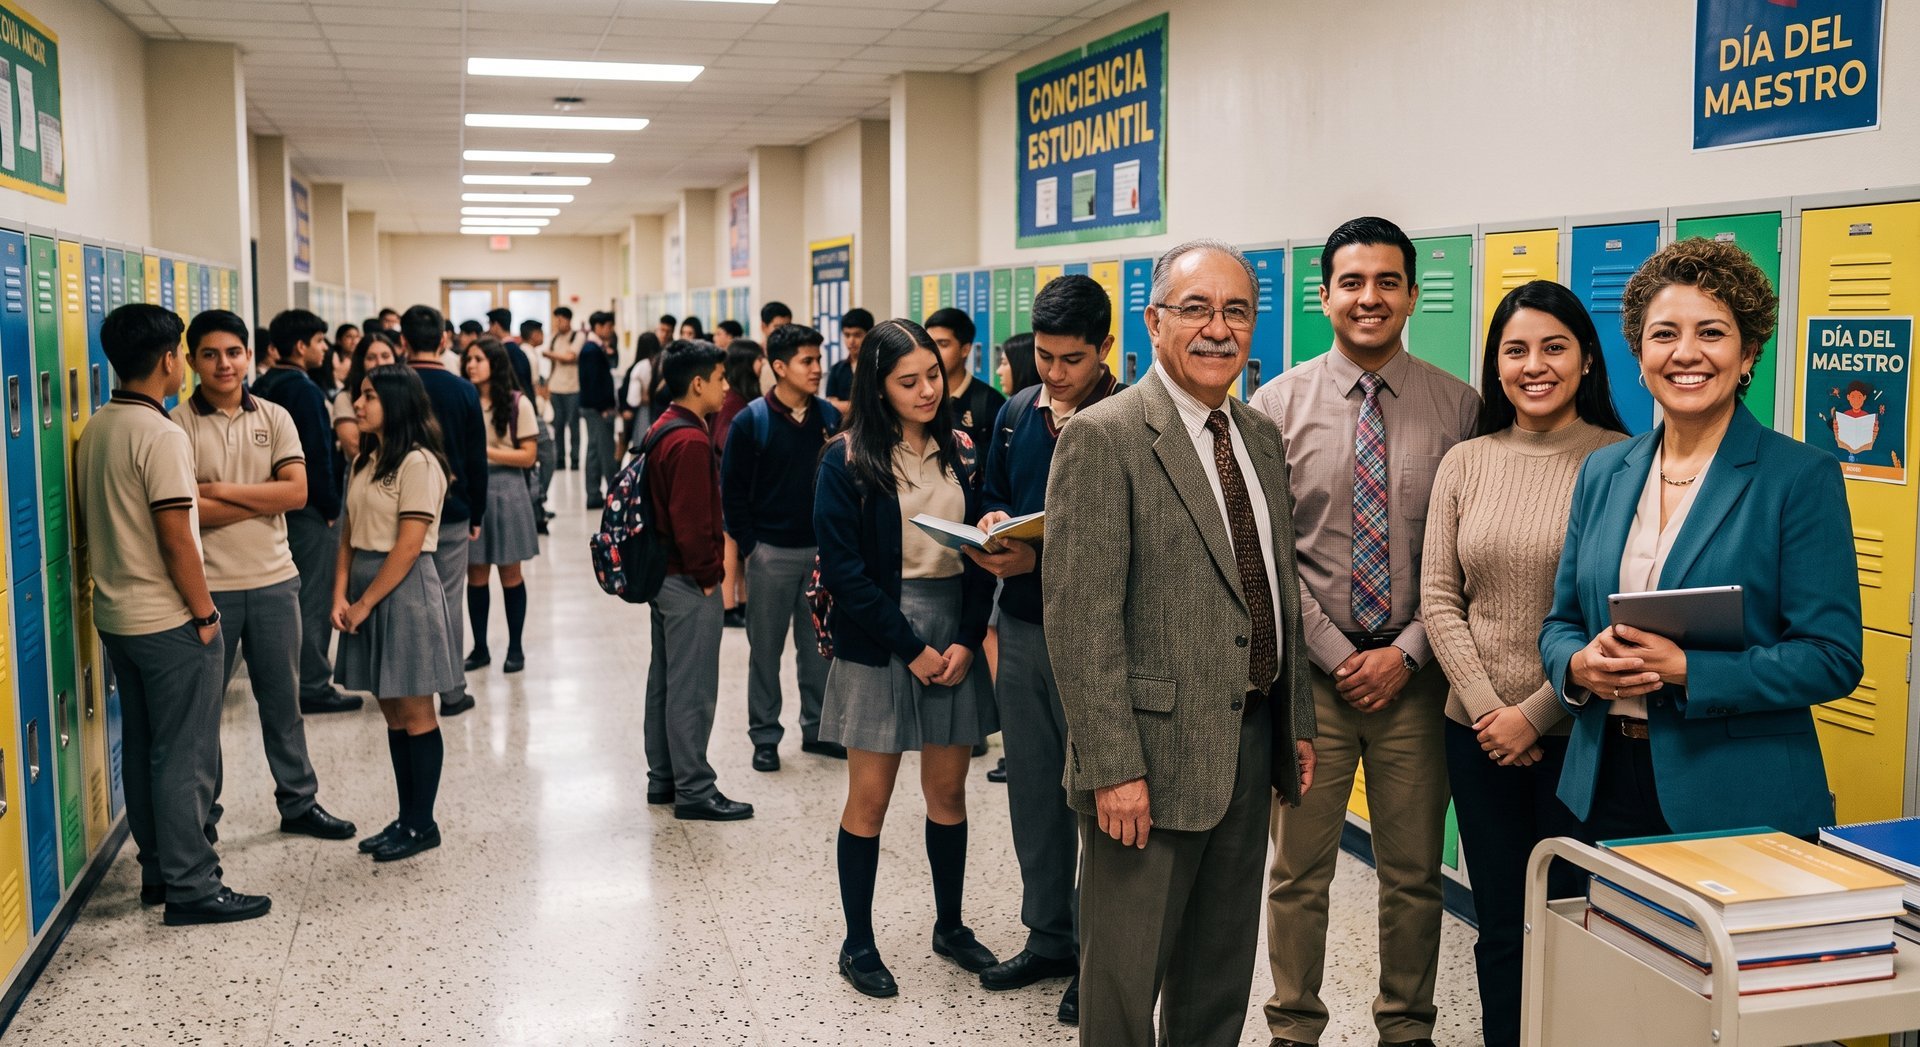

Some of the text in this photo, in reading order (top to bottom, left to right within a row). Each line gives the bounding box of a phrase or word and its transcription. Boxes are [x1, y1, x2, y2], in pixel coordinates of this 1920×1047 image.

[1719, 14, 1853, 72] DÍA DEL
[1029, 48, 1148, 125] CONCIENCIA
[1704, 59, 1867, 118] MAESTRO
[1028, 101, 1155, 171] ESTUDIANTIL
[1812, 352, 1905, 373] MAESTRO
[1821, 324, 1896, 348] DÍA DEL
